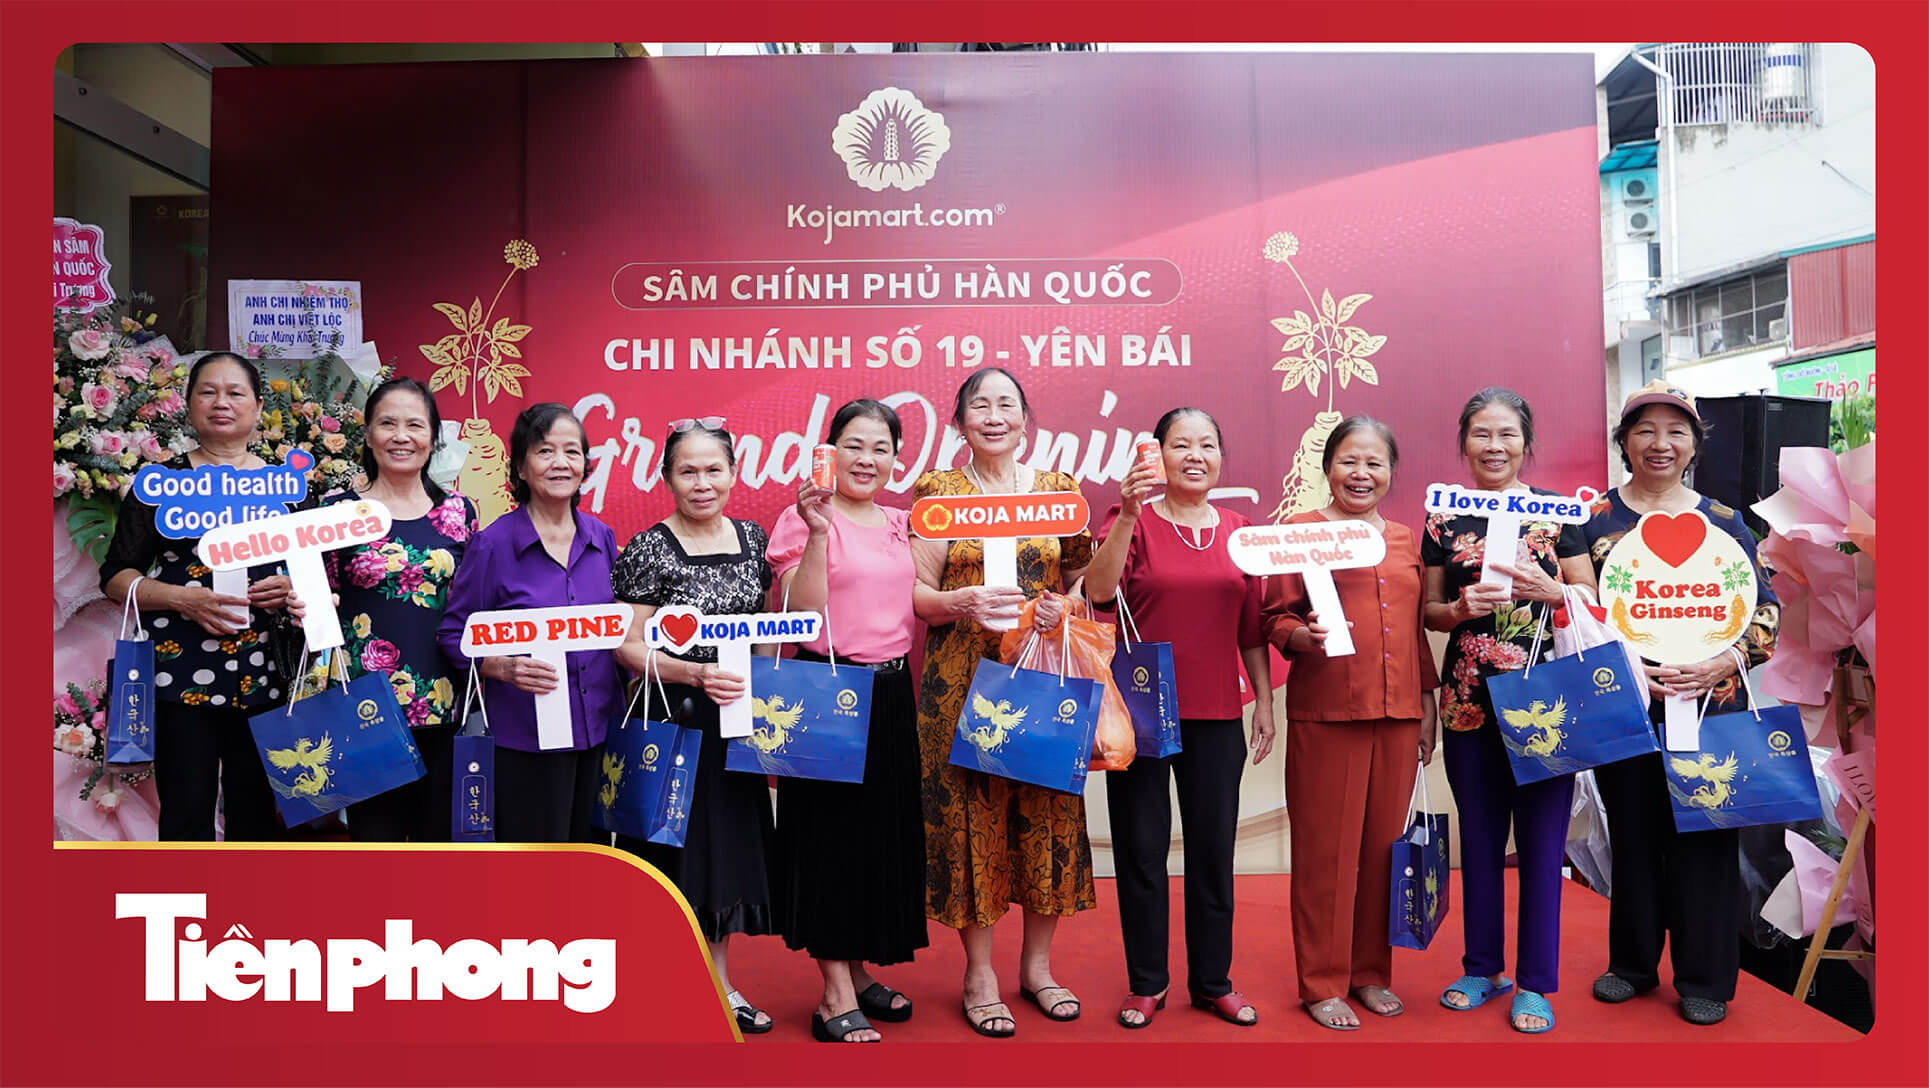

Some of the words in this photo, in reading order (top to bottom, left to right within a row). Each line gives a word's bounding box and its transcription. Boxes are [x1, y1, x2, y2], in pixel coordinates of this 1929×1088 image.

[64, 237, 89, 254] SÂM
[63, 257, 95, 277] QUỐC
[643, 269, 717, 302] SÂM
[731, 265, 850, 300] CHÍNH
[863, 265, 943, 299] PHỦ
[954, 264, 1031, 299] HÀN
[1044, 262, 1153, 304] QUỐC
[244, 296, 268, 309] ANH
[252, 313, 275, 326] ANH
[604, 339, 674, 371] CHI
[689, 328, 852, 370] NHÁNH
[866, 325, 924, 368] SỐ
[936, 335, 984, 367] 19
[1020, 325, 1106, 368] YÊN
[1121, 325, 1191, 367] BÁI
[143, 472, 212, 497] Good
[221, 472, 299, 496] health
[954, 505, 1011, 526] KOJA
[1016, 503, 1077, 523] MART
[1432, 491, 1442, 507] I
[1448, 492, 1499, 510] love
[1506, 496, 1582, 517] Korea
[165, 506, 233, 530] Good
[208, 532, 290, 566] Hello
[295, 516, 384, 549] Korea
[1284, 528, 1334, 543] chính
[1337, 524, 1371, 543] phủ
[1269, 550, 1307, 565] Hàn
[1309, 543, 1354, 566] Quốc
[1635, 580, 1721, 600] Korea
[1629, 603, 1727, 622] Ginseng
[471, 620, 538, 646] RED
[546, 614, 625, 641] PINE
[651, 627, 659, 642] I
[701, 621, 750, 641] KOJA
[756, 618, 816, 637] MART
